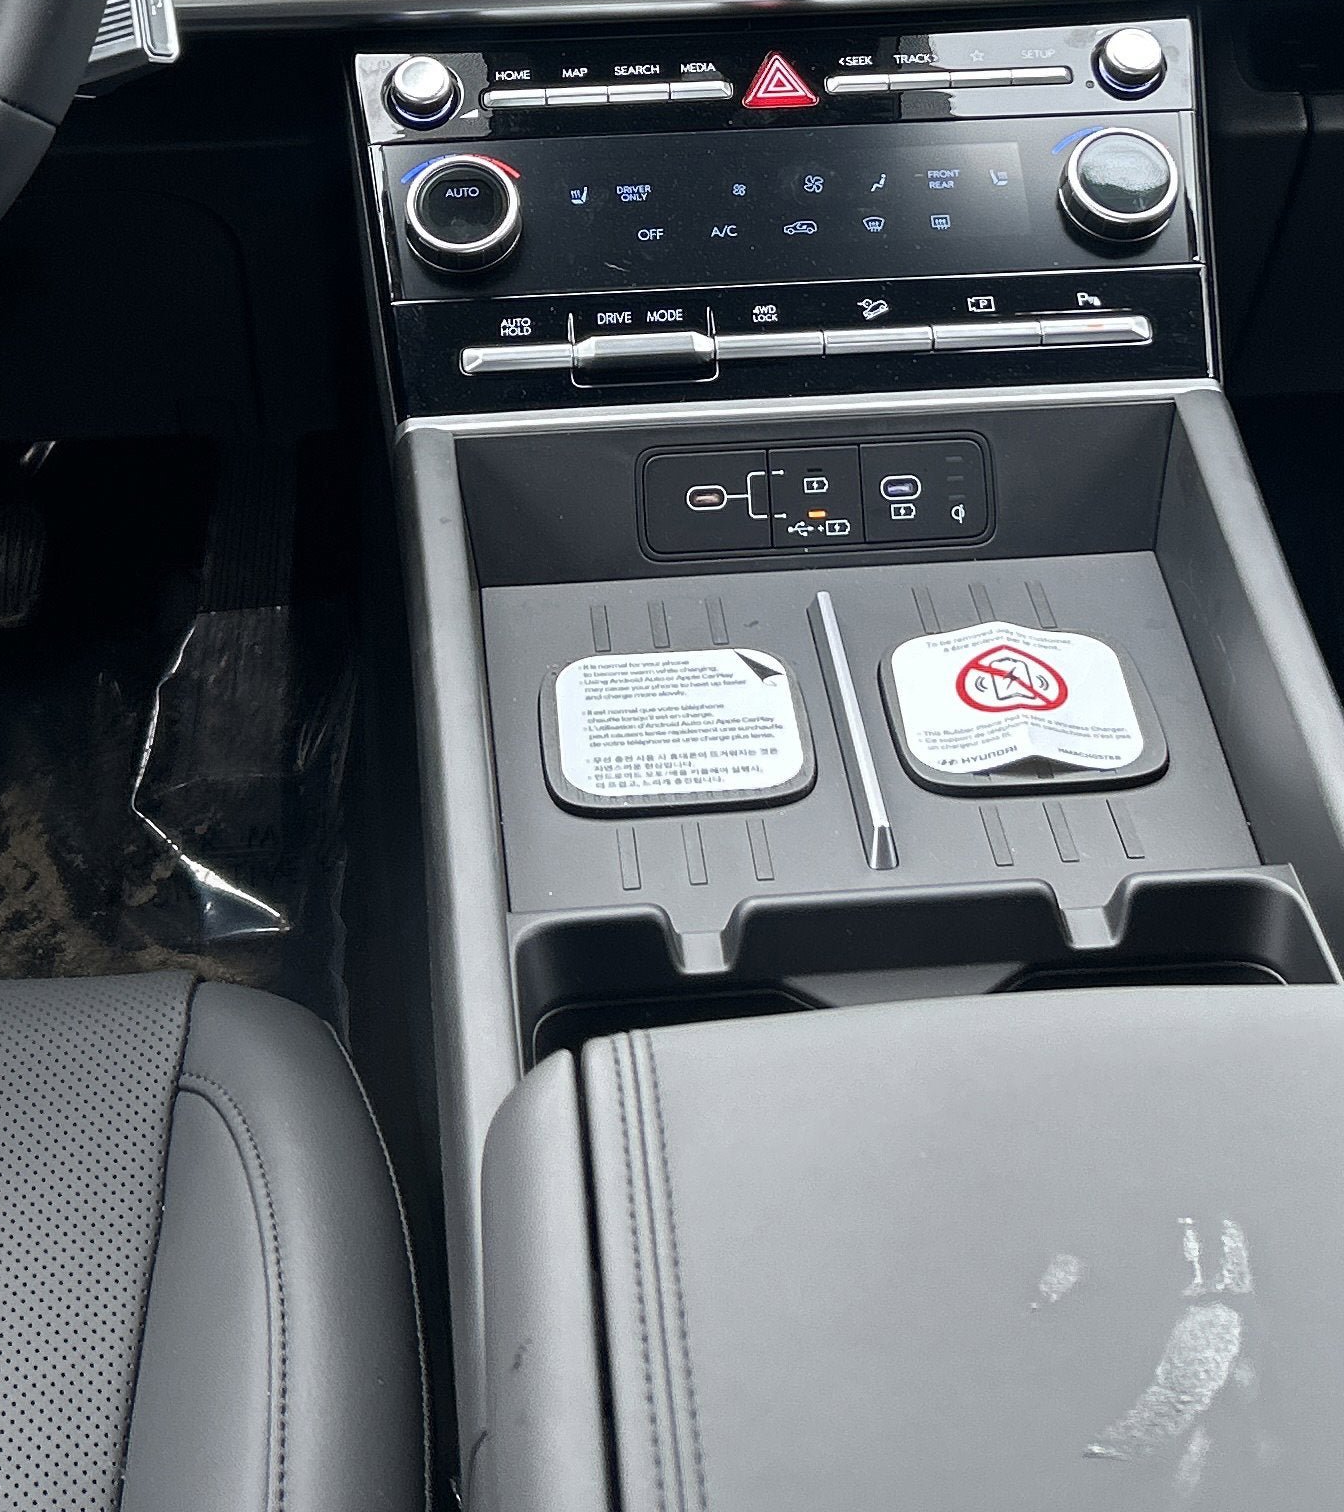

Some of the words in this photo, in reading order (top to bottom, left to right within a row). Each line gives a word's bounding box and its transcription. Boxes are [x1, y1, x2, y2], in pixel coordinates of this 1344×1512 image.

[1020, 49, 1056, 60] SETUP
[562, 67, 588, 79] MAP
[614, 64, 660, 76] SEARCH
[680, 63, 716, 74] MEDIA
[495, 69, 531, 81] HOME
[927, 169, 960, 179] FRONT
[616, 184, 652, 195] DRIVER
[928, 179, 955, 189] REAR
[445, 187, 479, 198] AUTO
[620, 192, 648, 203] ONLY
[637, 229, 664, 241] OFF
[711, 225, 738, 238] A/C
[752, 305, 777, 315] 4WD
[597, 312, 632, 325] DRIVE
[646, 309, 683, 323] MODE
[752, 313, 778, 322] LOCK
[500, 318, 531, 328] AUTO
[500, 326, 532, 336] HOLD
[961, 745, 1017, 764] HYUNDAI
